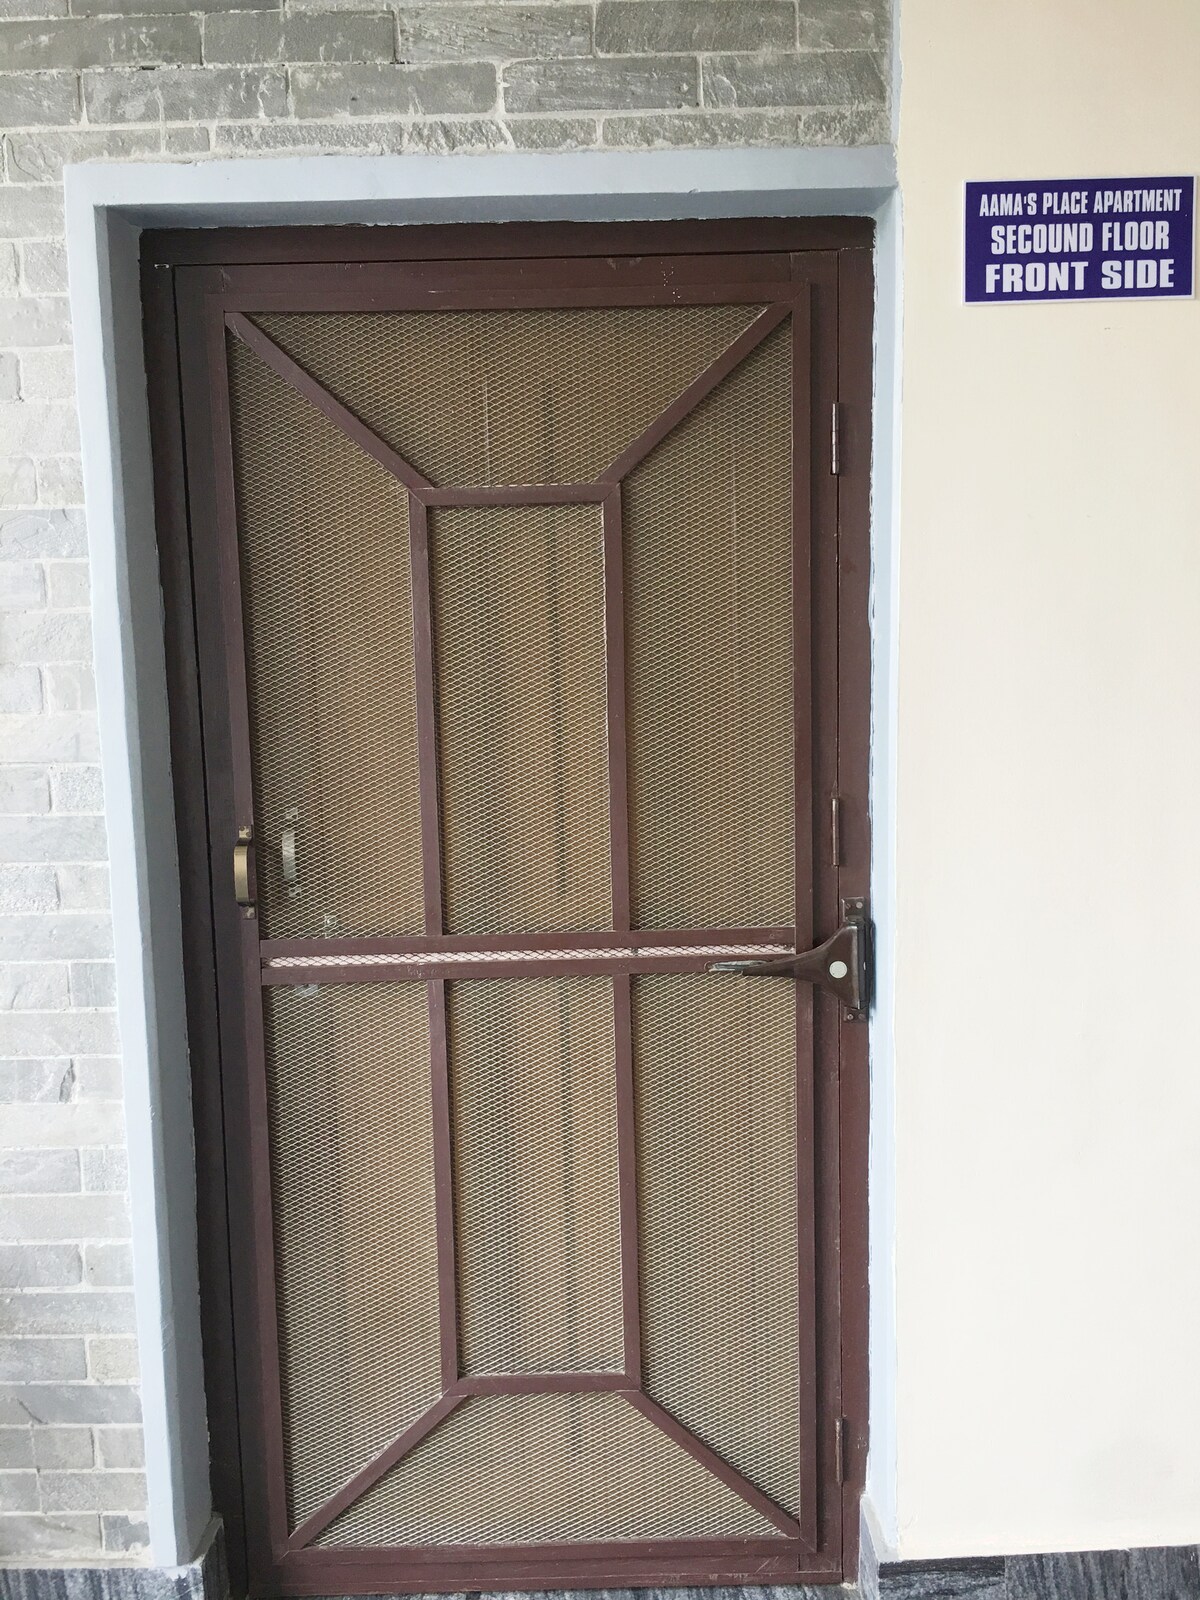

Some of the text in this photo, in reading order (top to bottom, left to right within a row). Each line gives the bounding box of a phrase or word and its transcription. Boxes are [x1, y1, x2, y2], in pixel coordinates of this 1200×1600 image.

[979, 188, 1183, 217] AAMA'S PLACE APARTMENT
[990, 220, 1170, 255] SECOUND FLOOR
[985, 258, 1175, 293] FRONT SIDE
